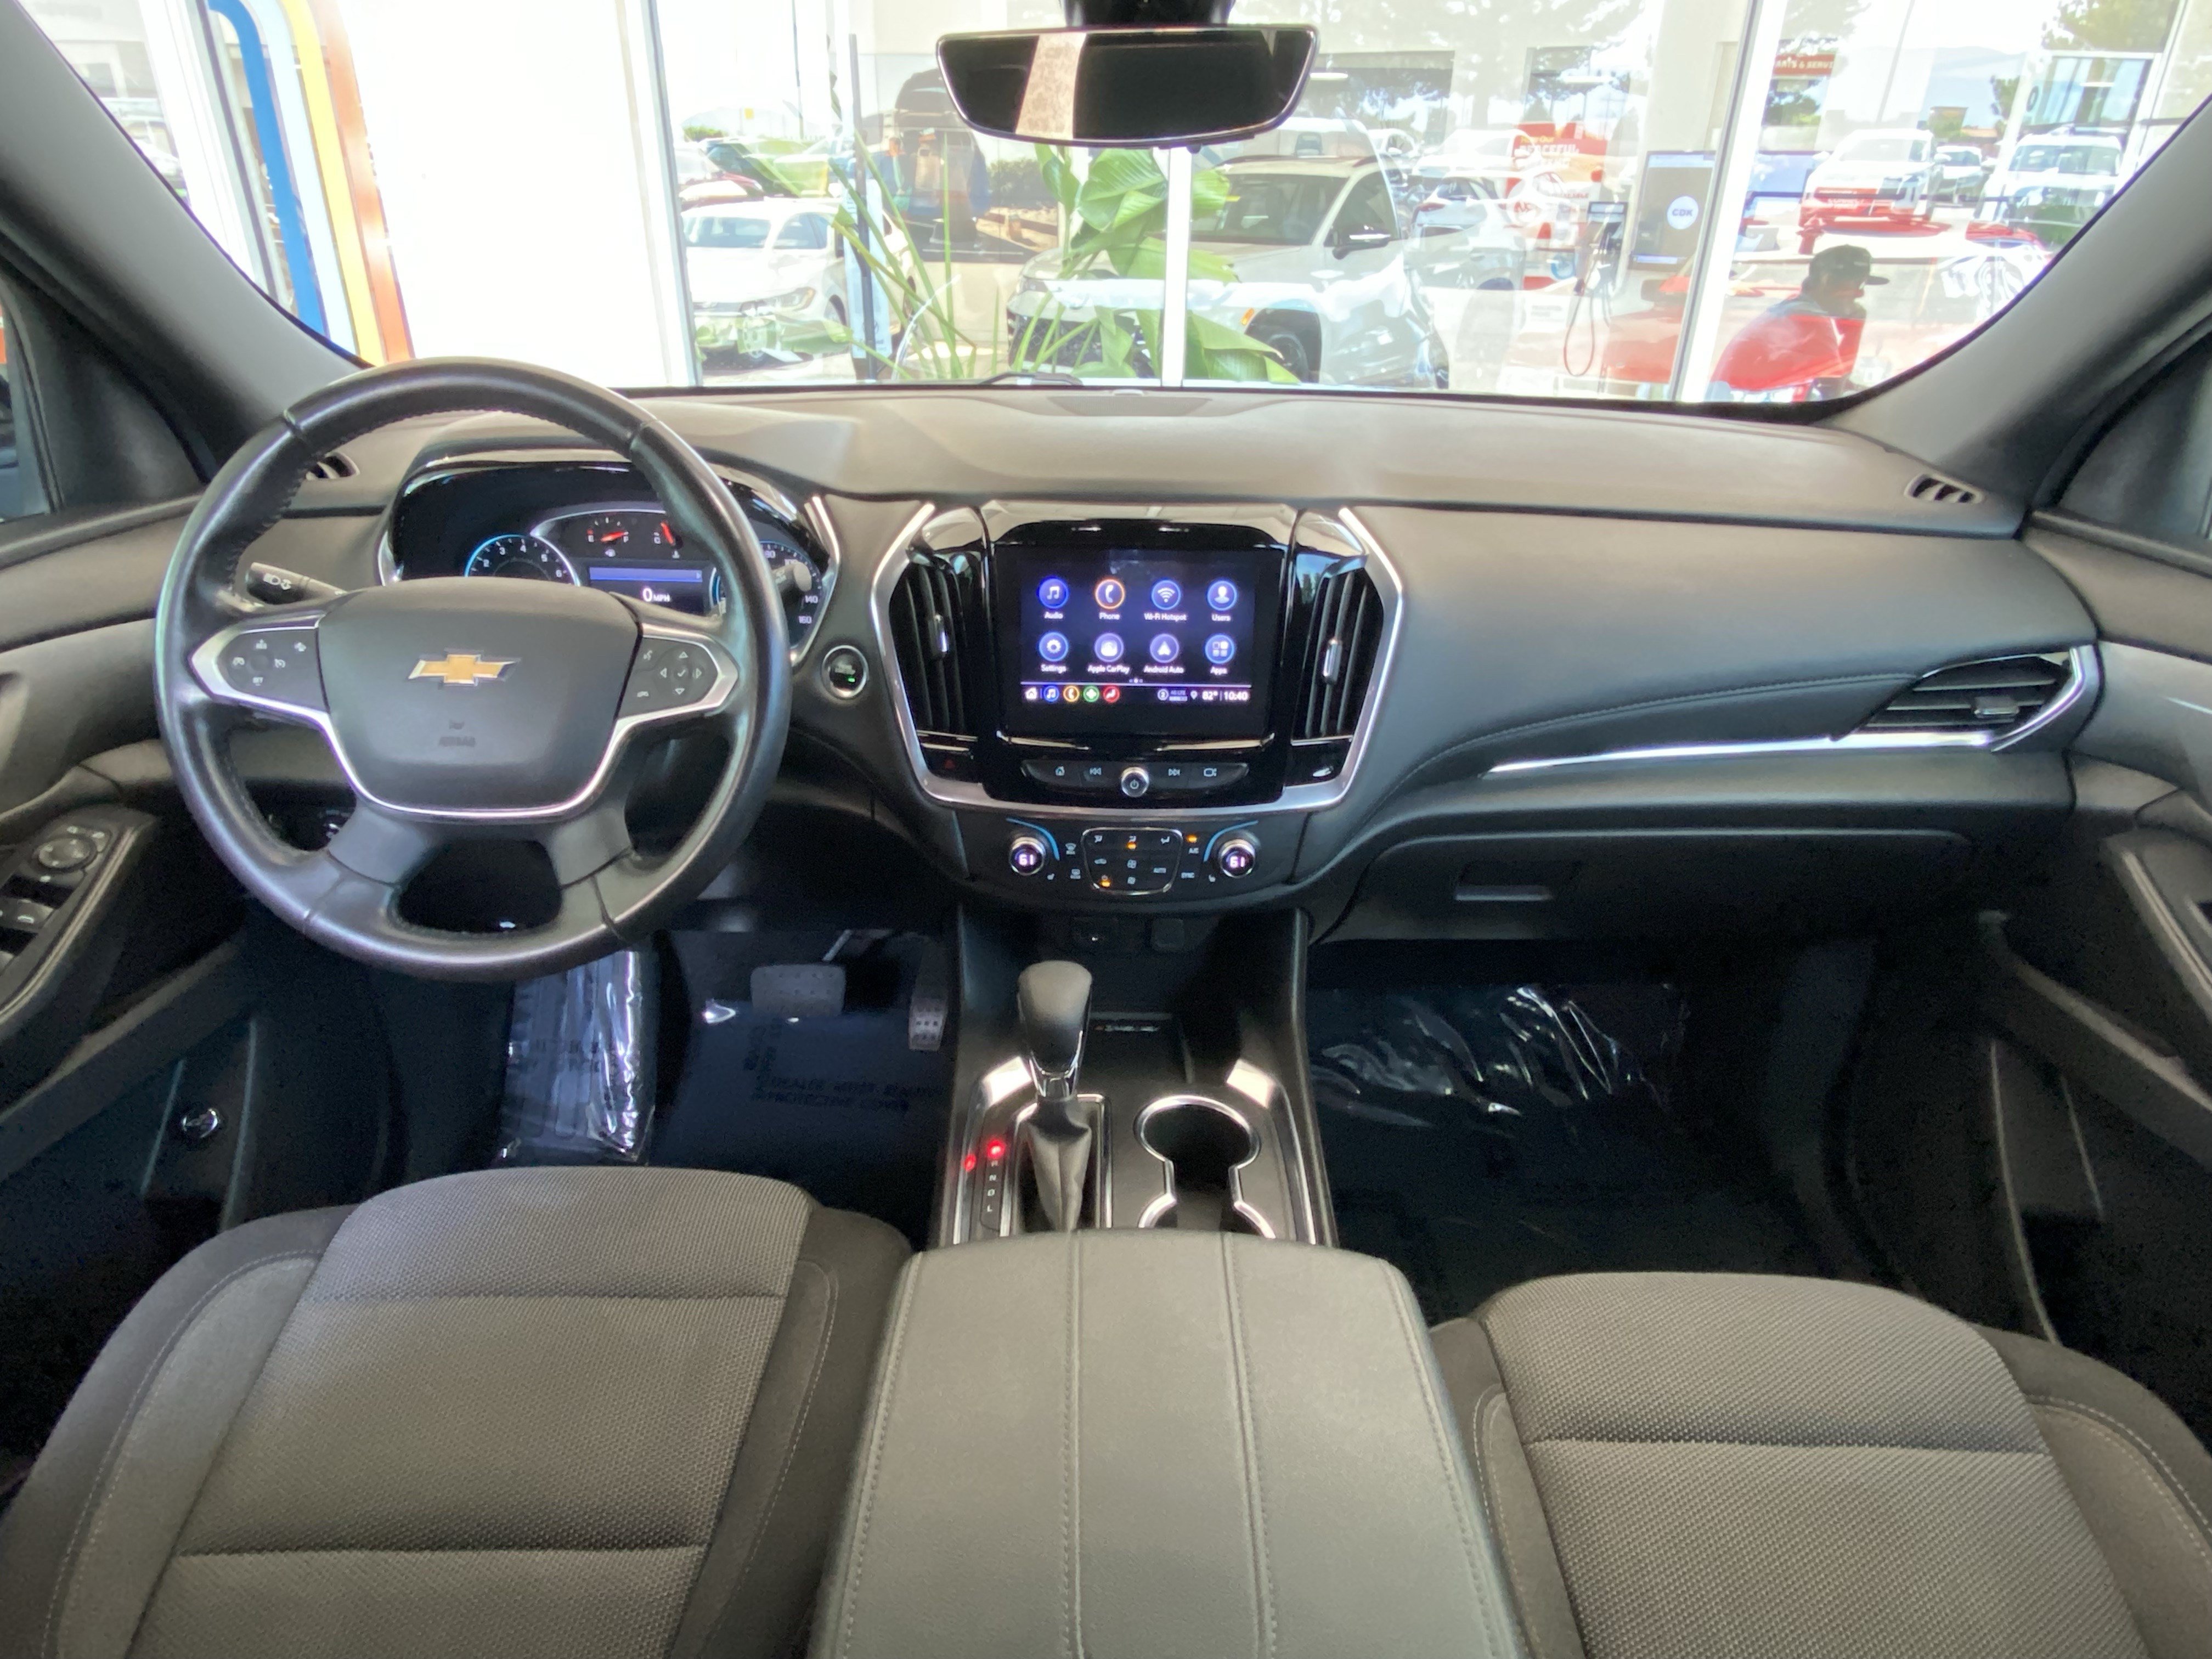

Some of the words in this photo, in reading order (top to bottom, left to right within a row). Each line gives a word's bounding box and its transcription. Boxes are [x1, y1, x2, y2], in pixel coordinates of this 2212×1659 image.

[499, 546, 506, 555] 3
[520, 545, 526, 553] 4
[540, 553, 548, 562] 5
[483, 559, 490, 567] 2
[642, 587, 653, 602] 0
[805, 595, 819, 603] 140
[1161, 613, 1187, 622] Hotspot
[1041, 664, 1067, 674] Settings
[1087, 665, 1105, 673] Apple
[1107, 665, 1130, 674] CarPlay
[1144, 665, 1168, 674] Android
[1210, 667, 1228, 675] Apps
[1224, 691, 1249, 701] 10:40
[1019, 854, 1034, 866] 61
[1230, 856, 1245, 868] 61
